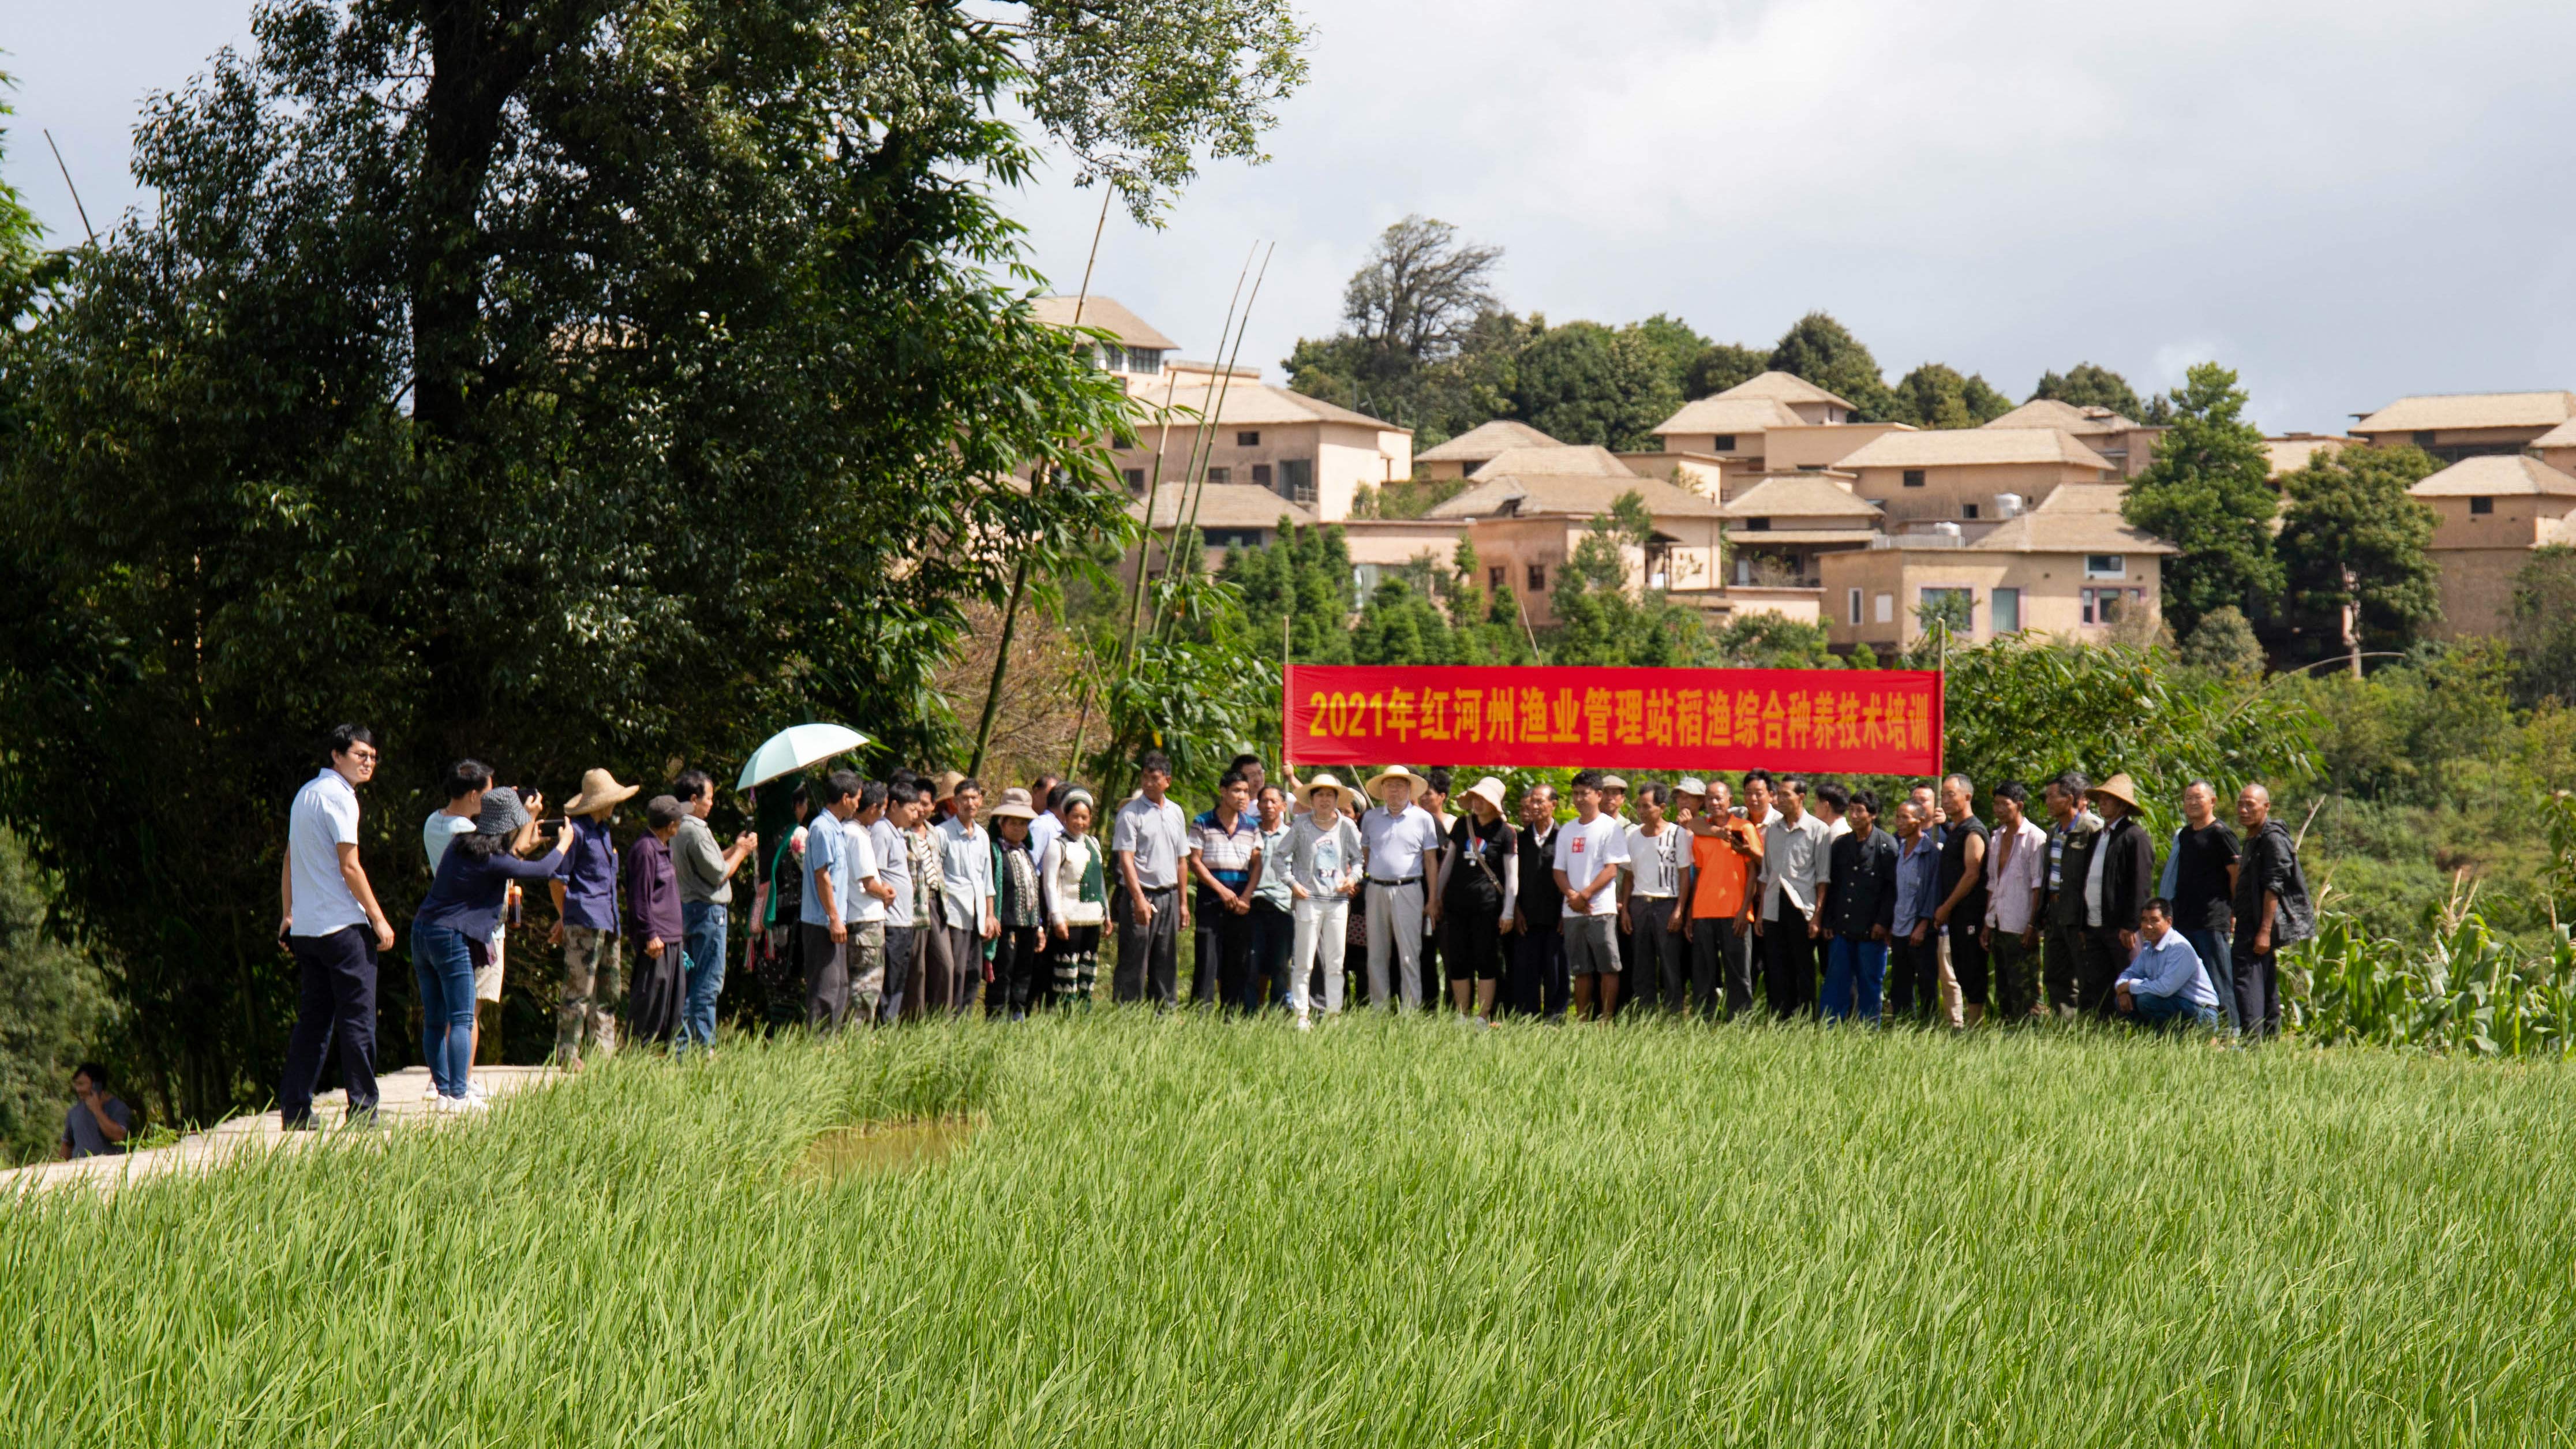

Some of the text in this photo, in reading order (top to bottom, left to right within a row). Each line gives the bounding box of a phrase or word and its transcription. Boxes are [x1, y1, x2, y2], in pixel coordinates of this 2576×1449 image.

[1309, 686, 1930, 752] 2021年红河州渔业管理站稻渔综合种养技术培训
[1657, 849, 1676, 863] Y-3
